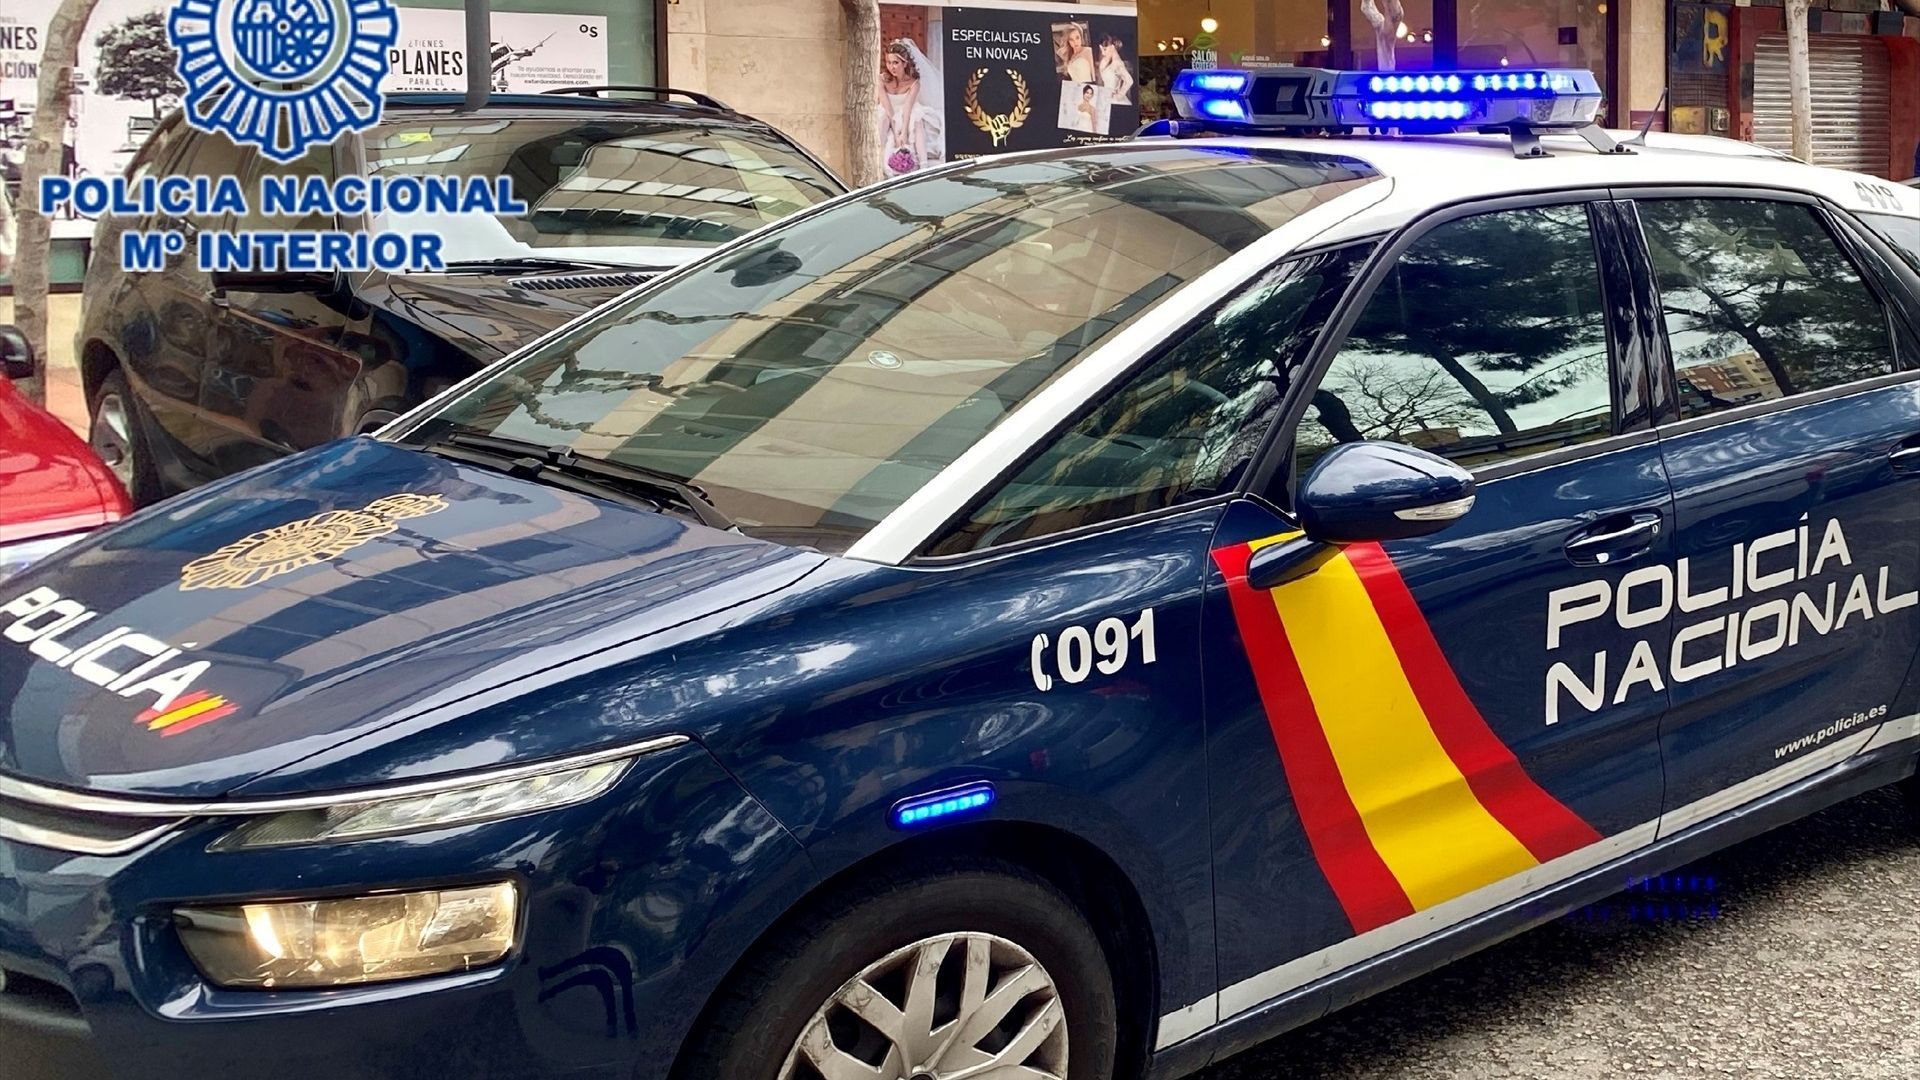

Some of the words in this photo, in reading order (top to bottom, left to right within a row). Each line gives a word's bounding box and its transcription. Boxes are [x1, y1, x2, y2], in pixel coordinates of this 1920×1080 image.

[389, 49, 463, 76] PLANES
[952, 29, 1041, 44] ESPECIALISTAS
[966, 46, 982, 59] EN
[985, 47, 1029, 60] NOVIAS
[1191, 48, 1218, 62] SALÓN
[1546, 512, 1852, 650] POLICÍA
[0, 586, 212, 712] POLICÍA
[1057, 607, 1157, 684] 091
[1545, 565, 1919, 726] NACIONAL
[1774, 704, 1888, 759] www.policia.es
